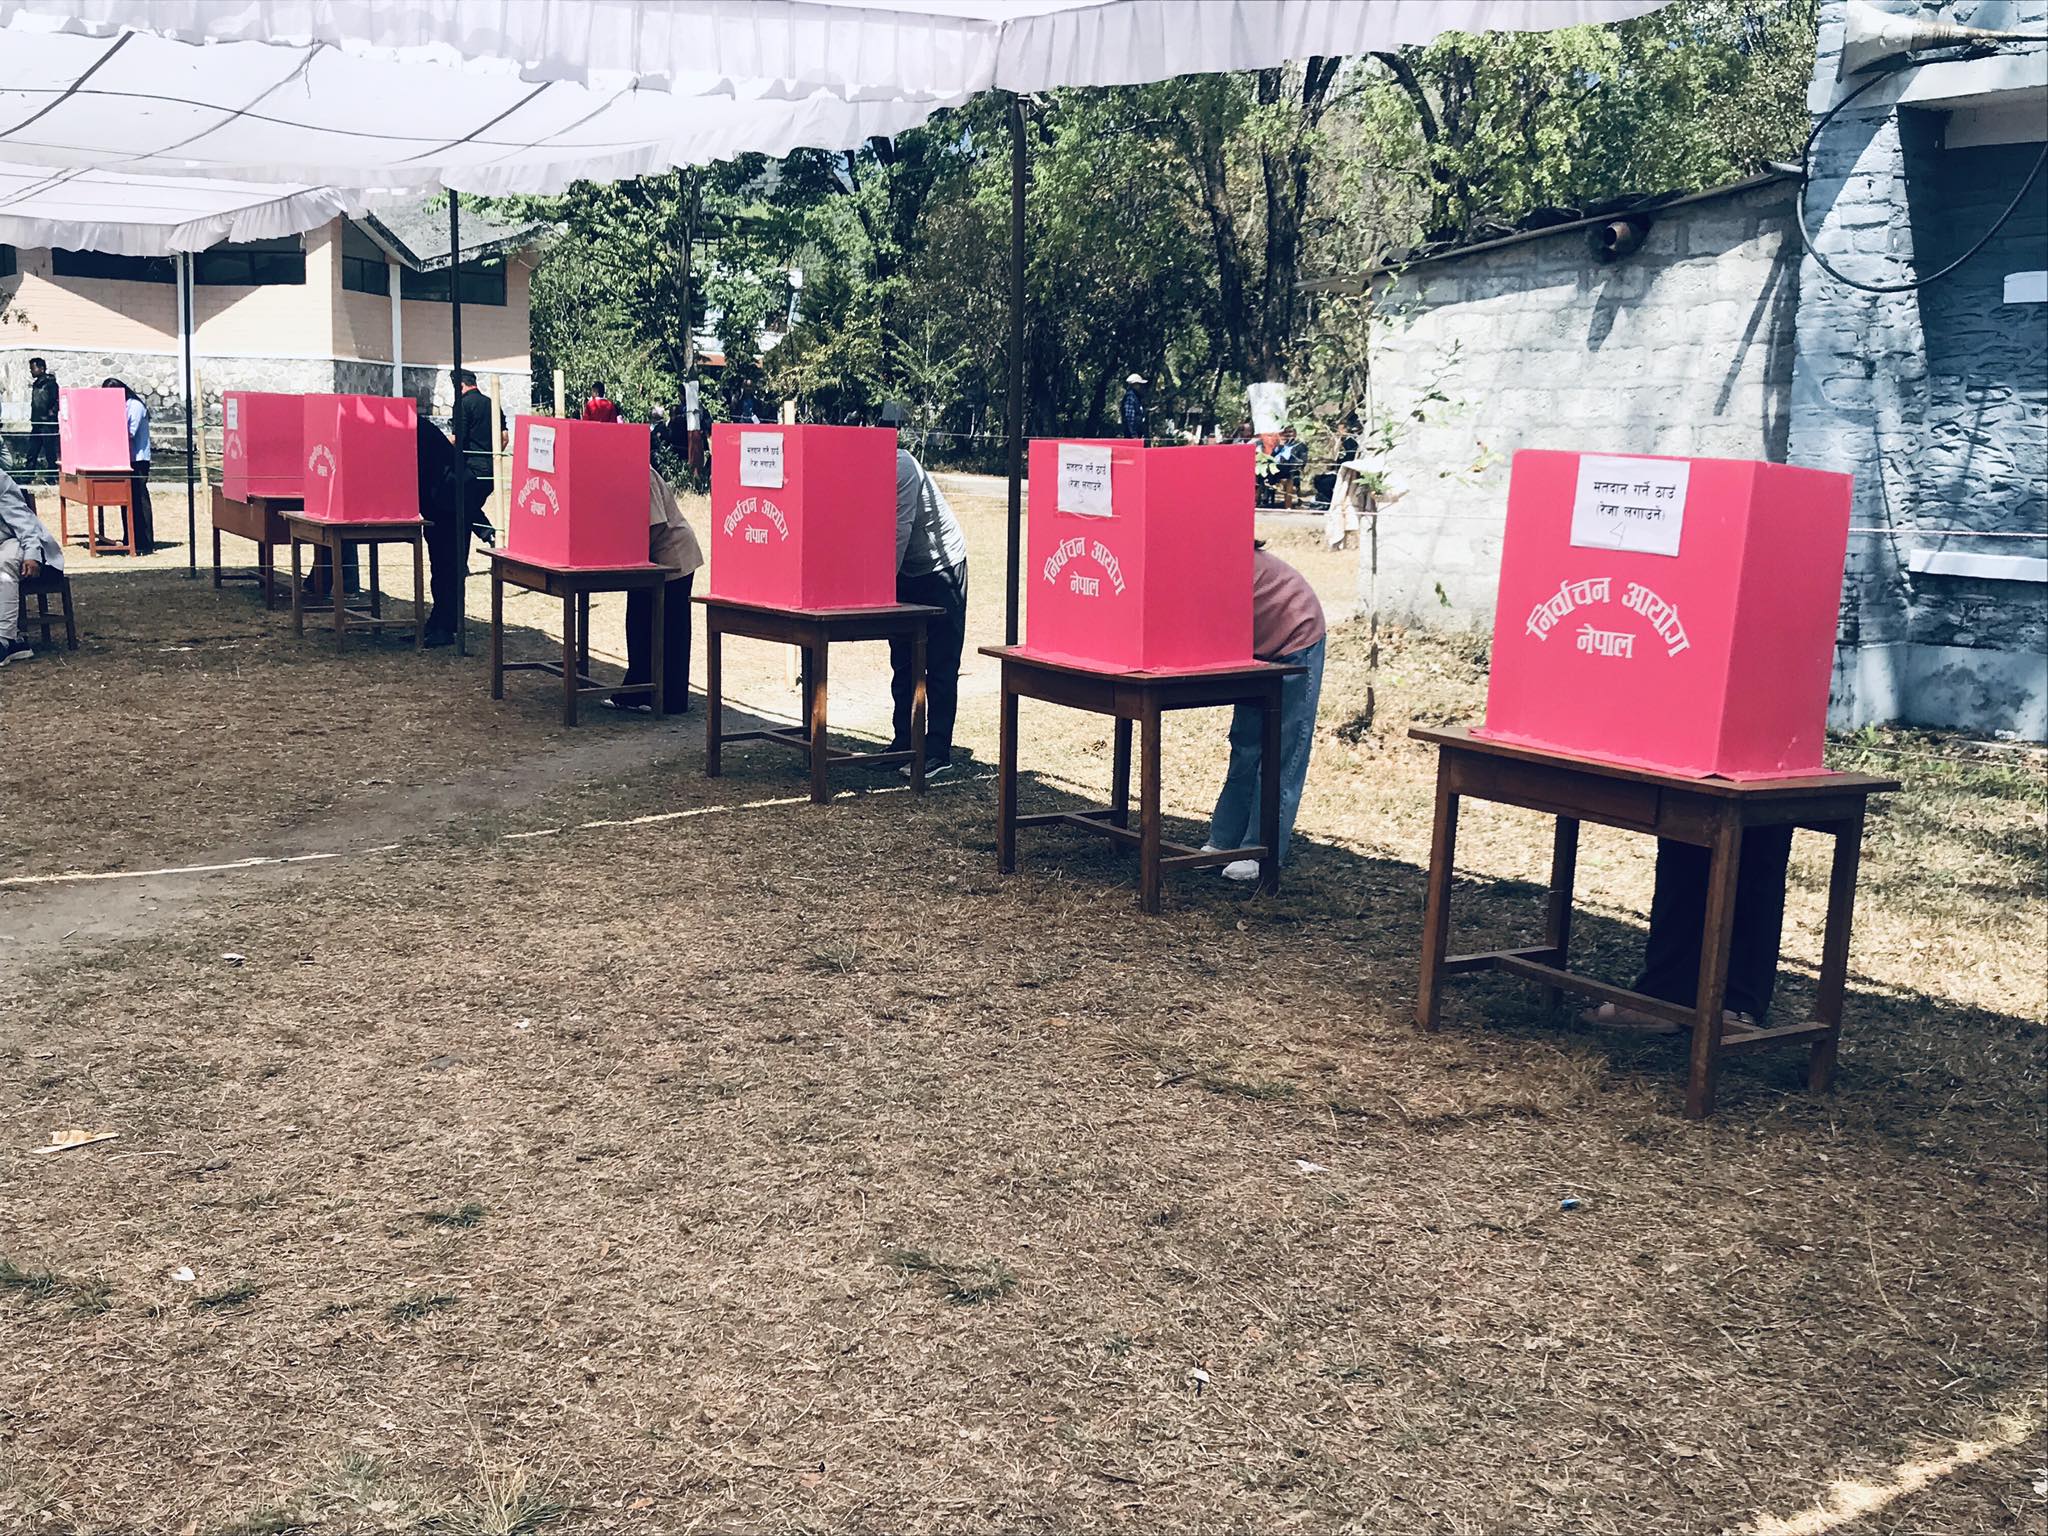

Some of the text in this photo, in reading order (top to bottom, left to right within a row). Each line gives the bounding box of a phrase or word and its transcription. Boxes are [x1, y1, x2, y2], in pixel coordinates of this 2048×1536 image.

[1594, 481, 1628, 495] मतदान
[1633, 481, 1651, 496] गर्ने
[723, 497, 789, 542] निर्वाचन आयोग
[744, 524, 768, 544] नेपाल
[1043, 537, 1126, 596] निर्वाचन आयोग
[1070, 571, 1100, 597] नेपाल
[1525, 577, 1691, 657] निर्वाचन आयोग
[1575, 623, 1636, 659] नेपाल
